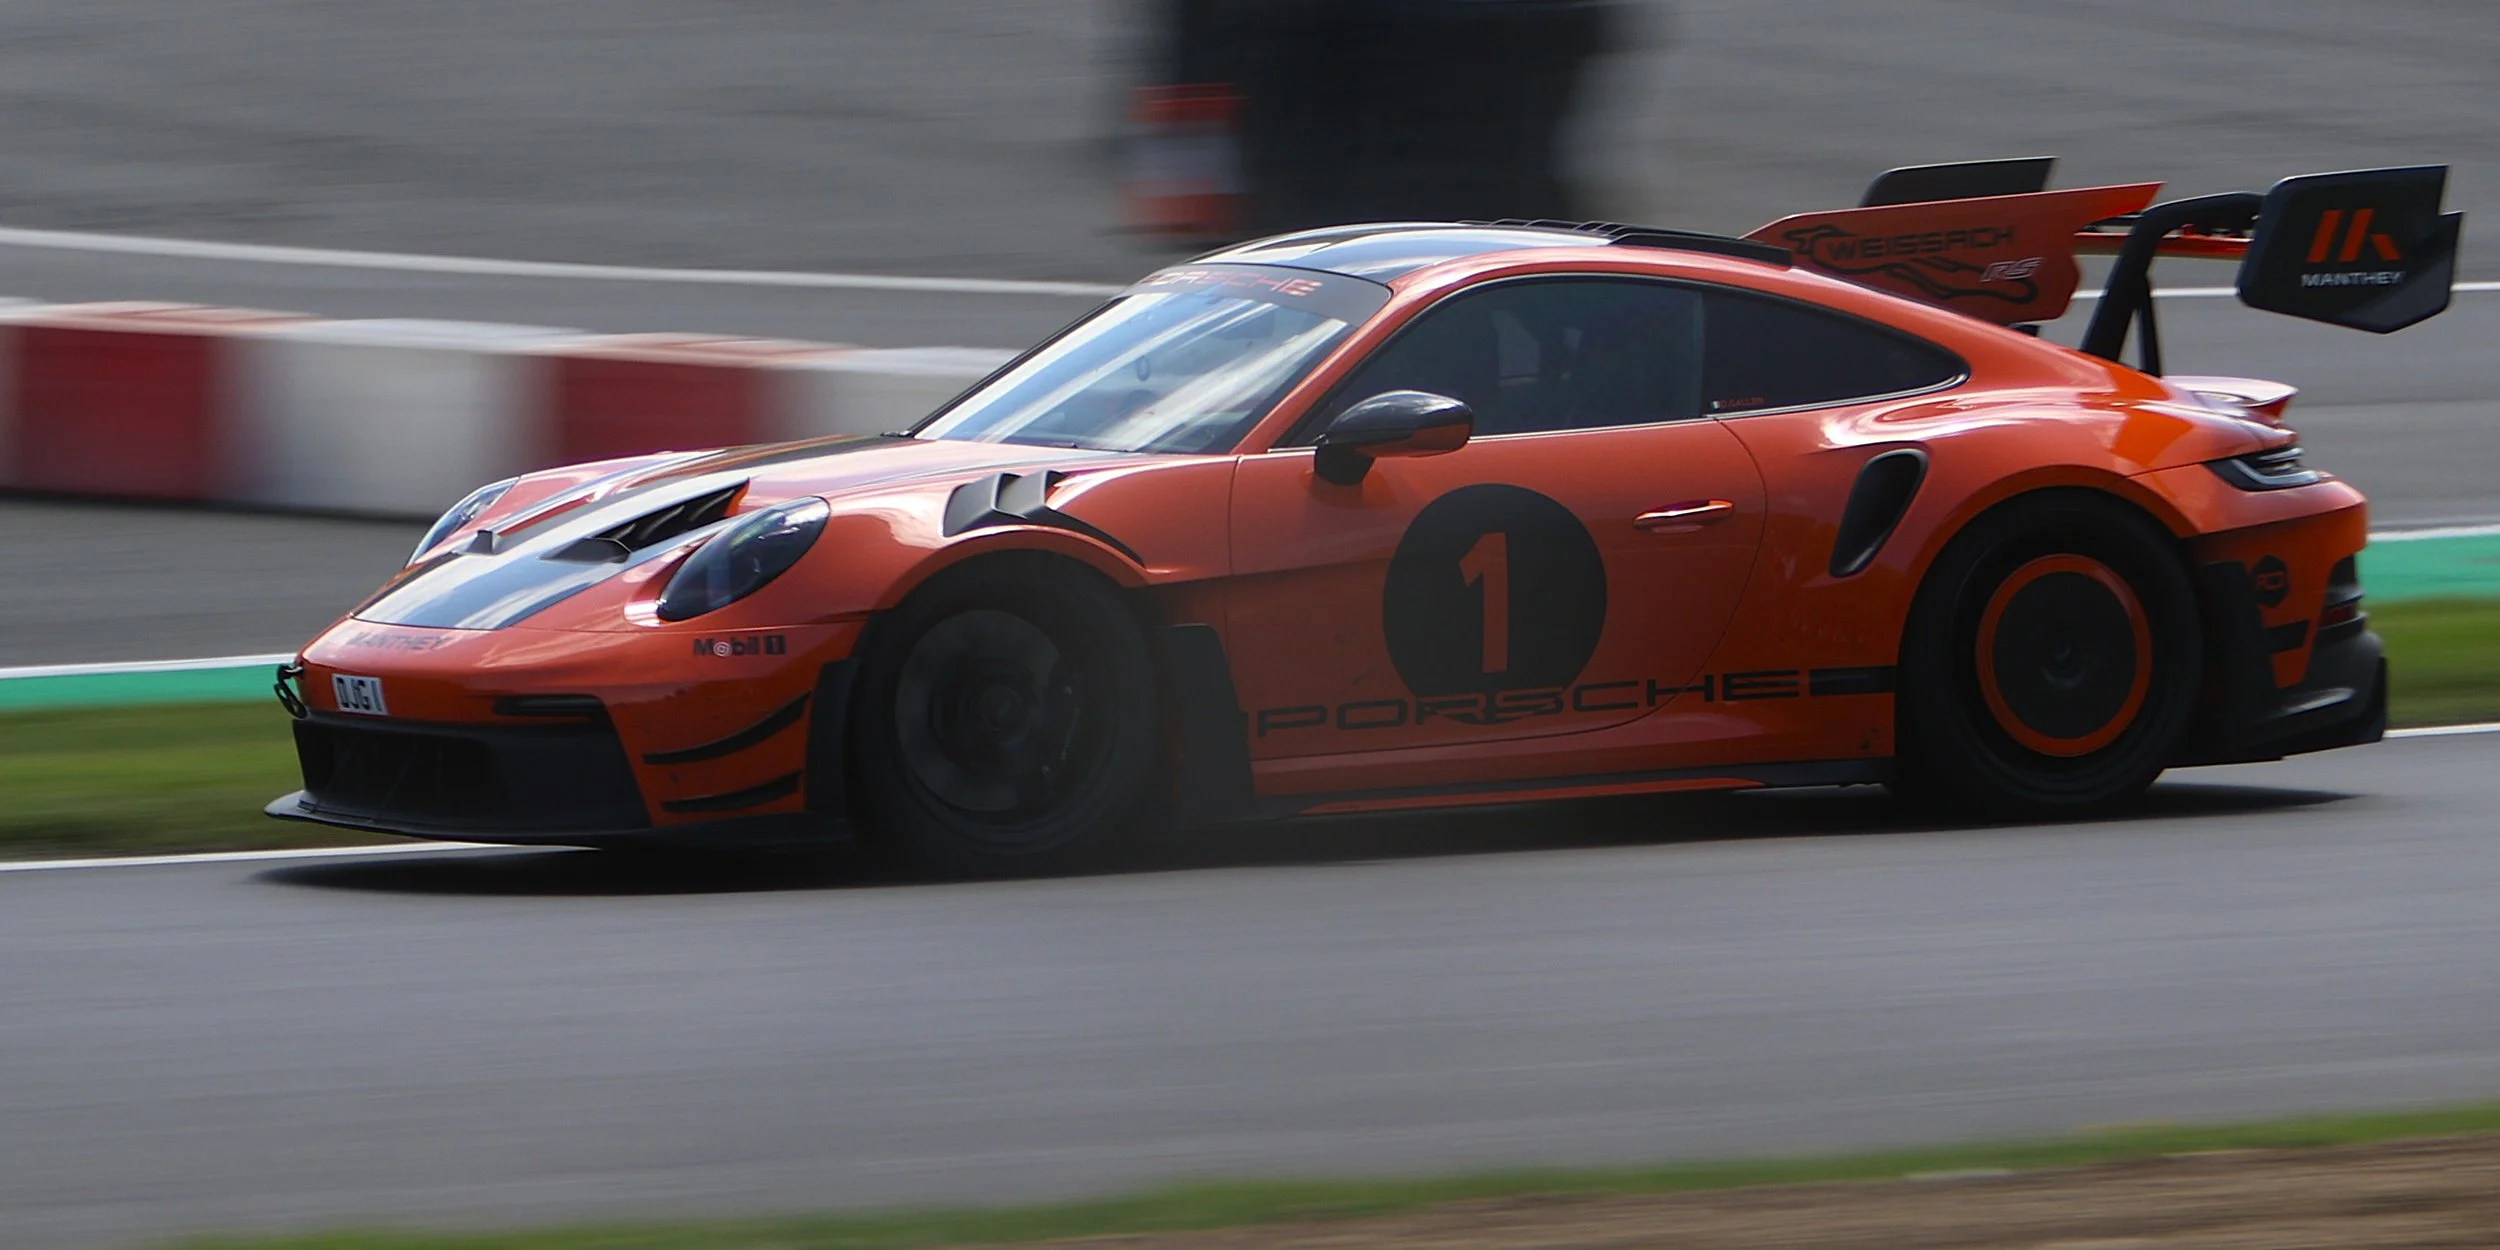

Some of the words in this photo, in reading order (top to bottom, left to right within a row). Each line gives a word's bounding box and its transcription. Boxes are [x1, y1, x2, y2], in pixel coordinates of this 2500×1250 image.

[1826, 226, 2014, 260] WEISSACH
[1980, 257, 2043, 282] RS
[2301, 271, 2405, 287] MANTHEY
[1458, 532, 1509, 673] 1
[694, 636, 758, 657] Mobil
[1257, 669, 1800, 738] PORSCHE
